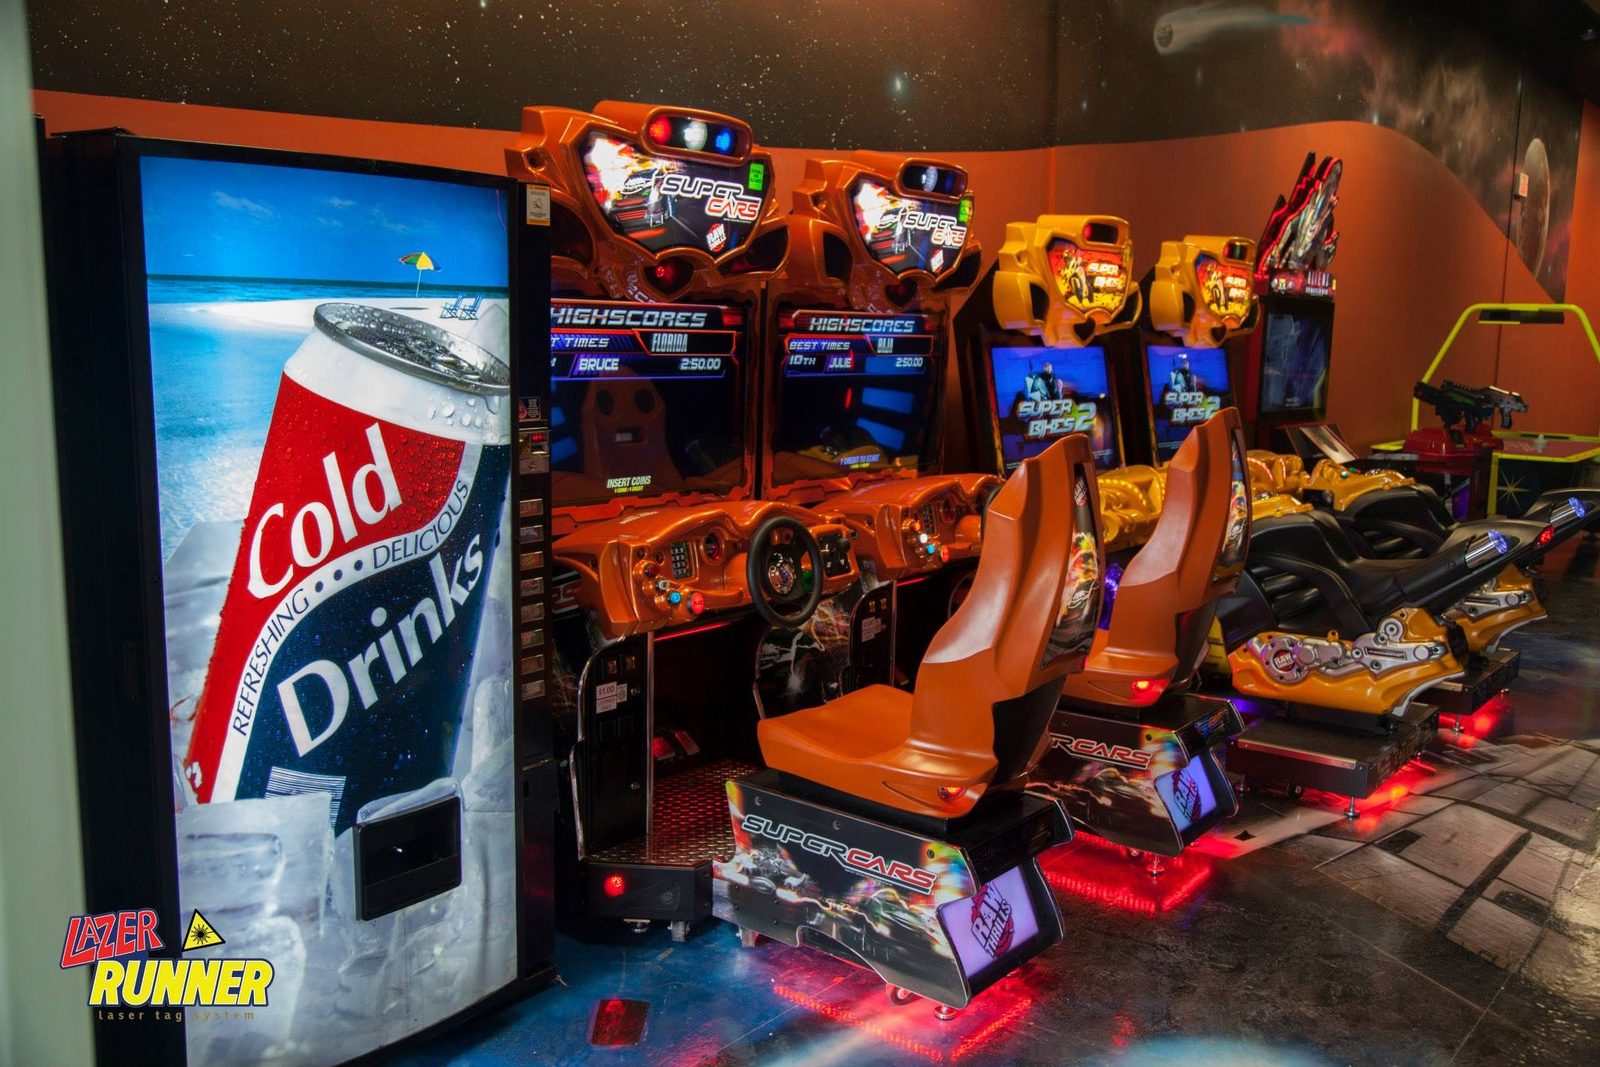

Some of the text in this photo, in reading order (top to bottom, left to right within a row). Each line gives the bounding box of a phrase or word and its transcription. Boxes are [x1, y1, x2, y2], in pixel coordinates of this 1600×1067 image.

[661, 174, 760, 202] SUPER
[706, 197, 760, 220] CARS
[904, 211, 966, 232] SUPER
[931, 229, 965, 246] CARS
[551, 308, 707, 327] HIGHSCORES
[809, 318, 915, 333] HIGHSCORES
[565, 338, 609, 348] TIMES
[651, 333, 688, 352] FLORIDA
[789, 341, 818, 350] BEST
[820, 341, 850, 350] TIMES
[579, 358, 722, 371] BRUCE 2:50.00
[789, 354, 816, 365] 10TH
[1018, 399, 1073, 417] SUPER
[1165, 392, 1204, 406] SUPER
[1028, 402, 1097, 437] BIKES 2
[1172, 408, 1206, 423] BIKES
[607, 475, 651, 488] INSERT COINS
[247, 422, 403, 600] Cold
[232, 479, 469, 737] REFRESHING DELICIOUS
[276, 534, 484, 758] Drinks
[1049, 733, 1153, 768] RCARS
[742, 814, 938, 893] SUPERCARS
[971, 882, 1004, 948] RAW
[984, 899, 1012, 957] THRILLS
